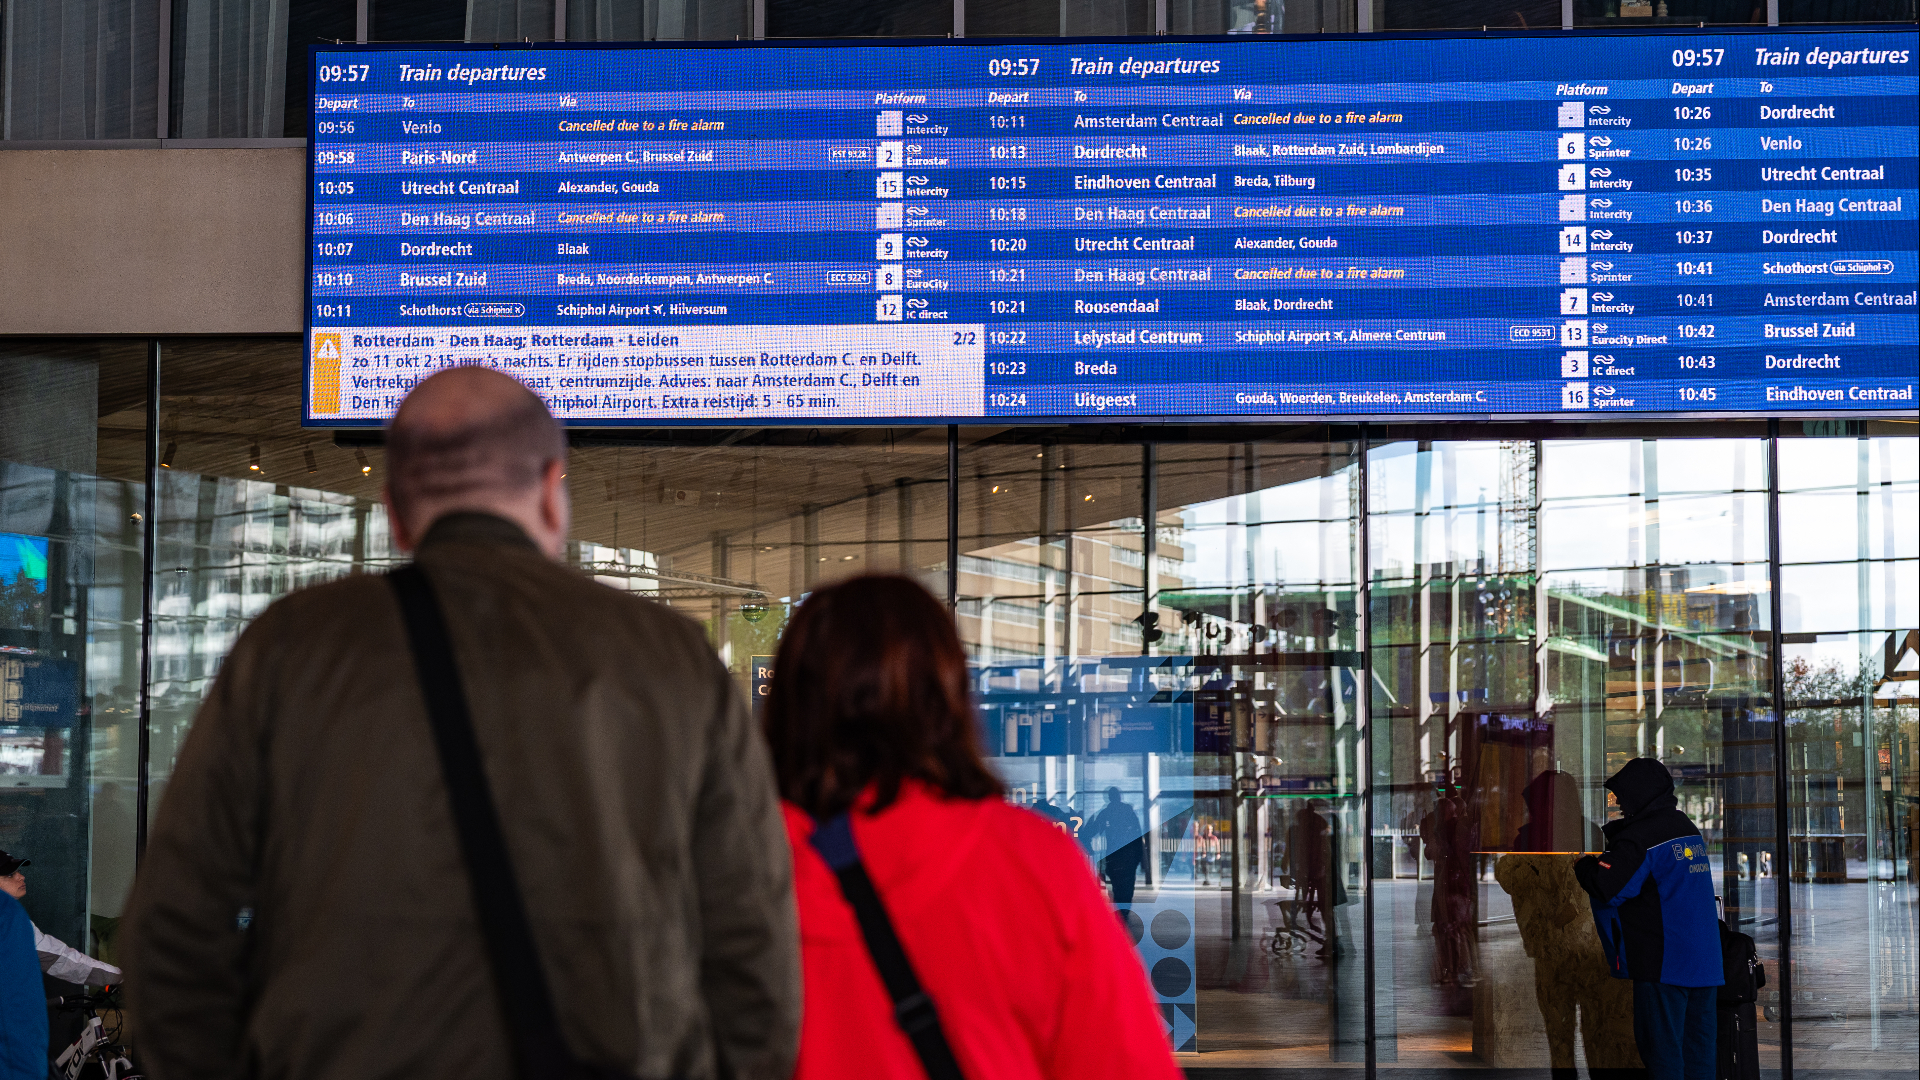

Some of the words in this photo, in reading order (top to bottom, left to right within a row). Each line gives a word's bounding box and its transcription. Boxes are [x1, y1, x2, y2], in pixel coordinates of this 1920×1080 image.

[1672, 48, 1725, 67] 09:57
[1755, 46, 1800, 66] Train
[1805, 46, 1910, 70] departures
[319, 64, 370, 83] 09:57
[399, 63, 442, 82] Train
[447, 63, 547, 86] departures
[988, 58, 1040, 77] 09:57
[1070, 56, 1114, 75] Train
[1119, 56, 1221, 79] departures
[1233, 88, 1252, 100] Via
[1555, 83, 1609, 96] Platform
[1671, 82, 1714, 97] Depart
[1760, 81, 1774, 93] To
[402, 96, 415, 108] To
[559, 94, 577, 107] Via
[874, 91, 927, 105] Platform
[987, 91, 1030, 105] Depart
[1074, 90, 1088, 102] To
[318, 97, 359, 112] Depart
[1760, 103, 1835, 120] Dordrecht
[1073, 113, 1158, 128] Amsterdam
[1161, 112, 1224, 128] Centraal
[1673, 106, 1712, 120] 10:26
[318, 120, 355, 134] 09:56
[402, 119, 442, 135] Venlo
[558, 119, 616, 132] Cancelled
[616, 119, 640, 132] due
[642, 120, 656, 131] to
[657, 122, 666, 131] a
[668, 118, 689, 131] fire
[690, 118, 725, 131] alarm
[989, 115, 1025, 129] 10:11
[906, 124, 949, 137] Intercity
[989, 145, 1026, 159] 10:13
[1074, 143, 1147, 159] Dordrecht
[1233, 143, 1270, 158] Blaak,
[1272, 143, 1336, 156] Rotterdam
[1338, 142, 1368, 157] Zuid,
[1370, 142, 1445, 158] Lombardijen
[1566, 141, 1576, 155] 6
[1588, 147, 1631, 160] Sprinter
[317, 151, 355, 164] 09:58
[401, 149, 477, 165] Paris-Nord
[558, 151, 623, 166] Antwerpen
[624, 150, 639, 164] C.,
[642, 149, 685, 163] Brussel
[687, 149, 714, 162] Zuid
[885, 149, 894, 163] 2
[906, 156, 949, 166] Eurostar
[1567, 172, 1576, 185] 4
[1674, 167, 1712, 182] 10:35
[1761, 165, 1817, 182] Utrecht
[1820, 164, 1884, 181] Centraal
[318, 181, 355, 195] 10:05
[401, 180, 455, 195] Utrecht
[458, 179, 519, 195] Centraal
[557, 180, 619, 195] Alexander,
[621, 180, 660, 193] Gouda
[882, 180, 897, 193] 15
[990, 176, 1027, 190] 10:15
[1074, 174, 1151, 190] Eindhoven
[1154, 173, 1217, 189] Centraal
[1589, 178, 1633, 191] Intercity
[1675, 199, 1713, 214] 10:36
[1761, 198, 1792, 213] Den
[1795, 198, 1835, 217] Haag
[1838, 196, 1902, 213] Centraal
[990, 238, 1027, 252] 10:20
[1074, 236, 1129, 252] Utrecht
[1132, 235, 1195, 251] Centraal
[1565, 233, 1581, 247] 14
[317, 242, 354, 256] 10:07
[400, 241, 473, 256] Dordrecht
[1676, 261, 1713, 276] 10:41
[1762, 261, 1829, 275] Schothorst
[1847, 260, 1881, 273] Schiphol
[317, 272, 354, 286] 10:10
[399, 271, 452, 287] Brussel
[455, 271, 487, 287] Zuid
[557, 272, 594, 287] Breda,
[596, 272, 694, 288] Noorderkempen,
[695, 273, 761, 288] Antwerpen
[763, 272, 775, 285] C.
[884, 272, 894, 286] 8
[1676, 293, 1713, 307] 10:41
[1763, 291, 1850, 307] Amsterdam
[1854, 290, 1918, 306] Centraal
[316, 304, 351, 317] 10:11
[399, 303, 462, 316] Schothorst
[557, 303, 607, 319] Schiphol
[608, 303, 650, 319] Airport
[669, 302, 728, 315] Hilversum
[882, 303, 897, 316] 12
[989, 300, 1025, 314] 10:21
[1074, 298, 1160, 314] Roosendaal
[1567, 327, 1583, 341] 13
[1677, 324, 1715, 338] 10:42
[1764, 322, 1819, 339] Brussel
[1822, 321, 1856, 338] Zuid
[352, 333, 435, 348] Rotterdam
[449, 334, 480, 348] Den
[483, 334, 527, 351] Haag;
[531, 332, 614, 347] Rotterdam
[628, 331, 679, 347] Leiden
[953, 331, 976, 346] 2/2
[989, 330, 1027, 345] 10:22
[1074, 329, 1136, 349] Lelystad
[1138, 329, 1203, 344] Centrum
[1636, 334, 1668, 345] Direct
[352, 356, 369, 368] zo
[373, 354, 390, 368] 11
[395, 353, 420, 368] okt
[423, 354, 455, 368] 2:15
[503, 353, 554, 368] nachts.
[557, 353, 572, 368] Er
[576, 353, 619, 372] rijden
[623, 353, 704, 371] stopbussen
[708, 355, 756, 367] tussen
[760, 352, 838, 367] Rotterdam
[841, 352, 854, 366] C.
[859, 355, 878, 366] en
[881, 352, 922, 366] Delft.
[989, 361, 1026, 375] 10:23
[1074, 360, 1118, 376] Breda
[1571, 359, 1580, 373] 3
[1678, 355, 1716, 369] 10:43
[1765, 353, 1841, 370] Dordrecht
[1592, 366, 1603, 376] IC
[1605, 365, 1635, 376] direct
[990, 393, 1027, 407] 10:24
[1235, 391, 1278, 406] Gouda,
[1279, 391, 1336, 405] Woerden,
[1339, 390, 1402, 405] Breukelen,
[1403, 390, 1473, 403] Amsterdam
[1475, 390, 1487, 403] C.
[1568, 390, 1584, 404] 16
[1678, 387, 1717, 401] 10:45
[1766, 385, 1844, 402] Eindhoven
[1848, 384, 1913, 401] Centraal
[1074, 391, 1137, 411] Uitgeest
[1592, 397, 1635, 409] Sprinter
